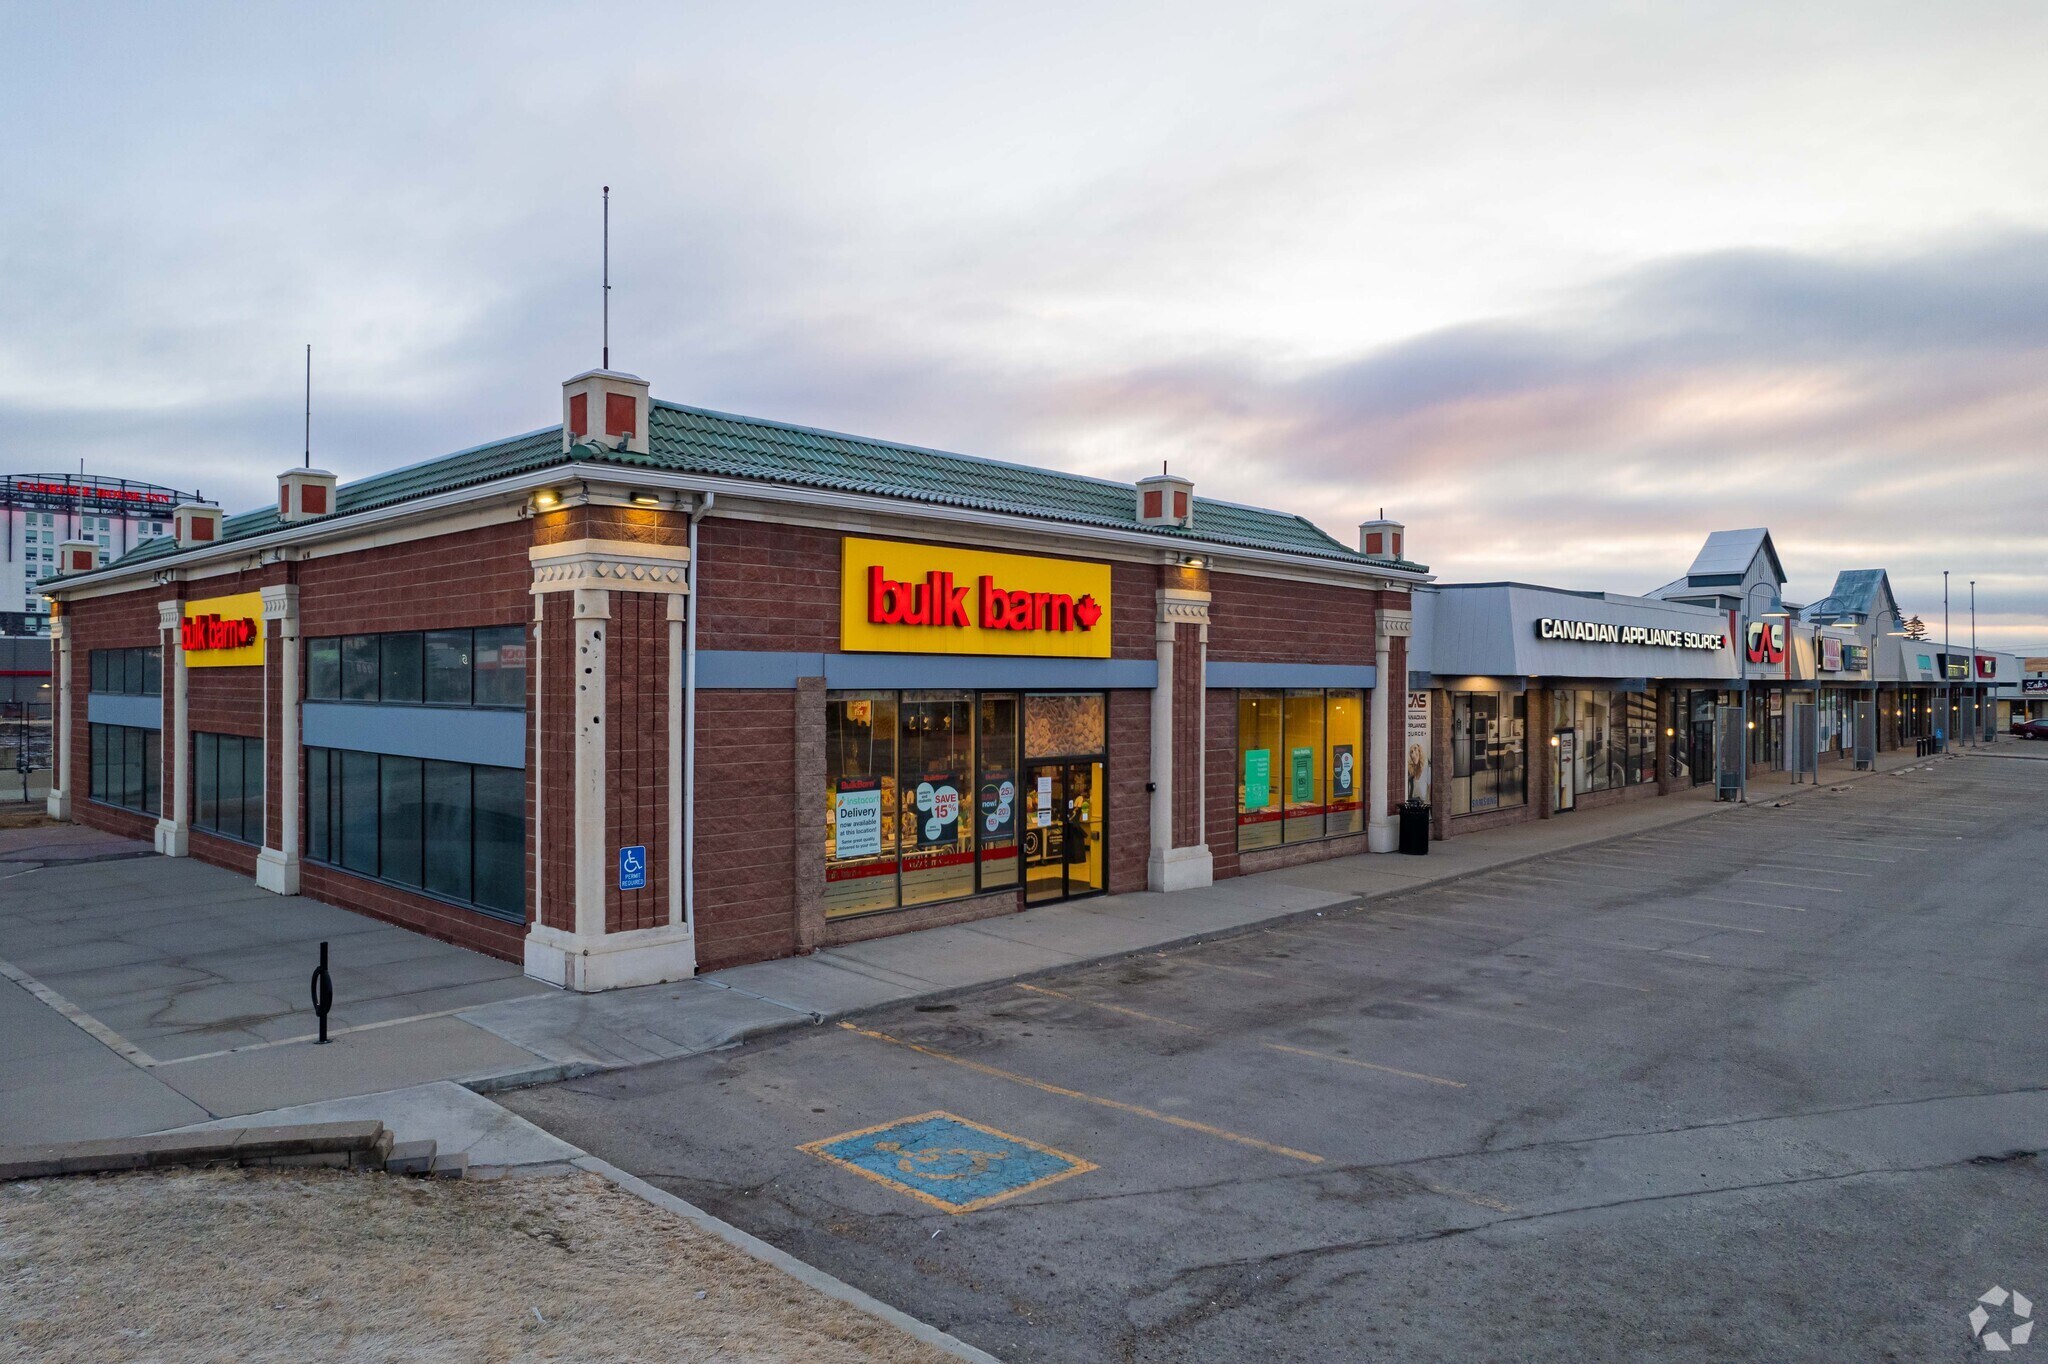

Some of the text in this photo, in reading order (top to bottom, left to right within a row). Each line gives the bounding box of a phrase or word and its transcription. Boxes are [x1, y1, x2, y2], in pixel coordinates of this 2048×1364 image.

[145, 493, 169, 503] INN
[868, 566, 1073, 631] bulk barn
[182, 614, 238, 650] bulk barn
[1540, 617, 1722, 650] CANADIAN APPLIANCE SOURCE
[1746, 621, 1784, 663] CAS
[847, 796, 879, 806] instacart
[935, 794, 957, 803] SAVE
[982, 799, 997, 807] now!
[840, 808, 876, 819] Delivery
[934, 804, 957, 818] 15%
[853, 819, 876, 827] available
